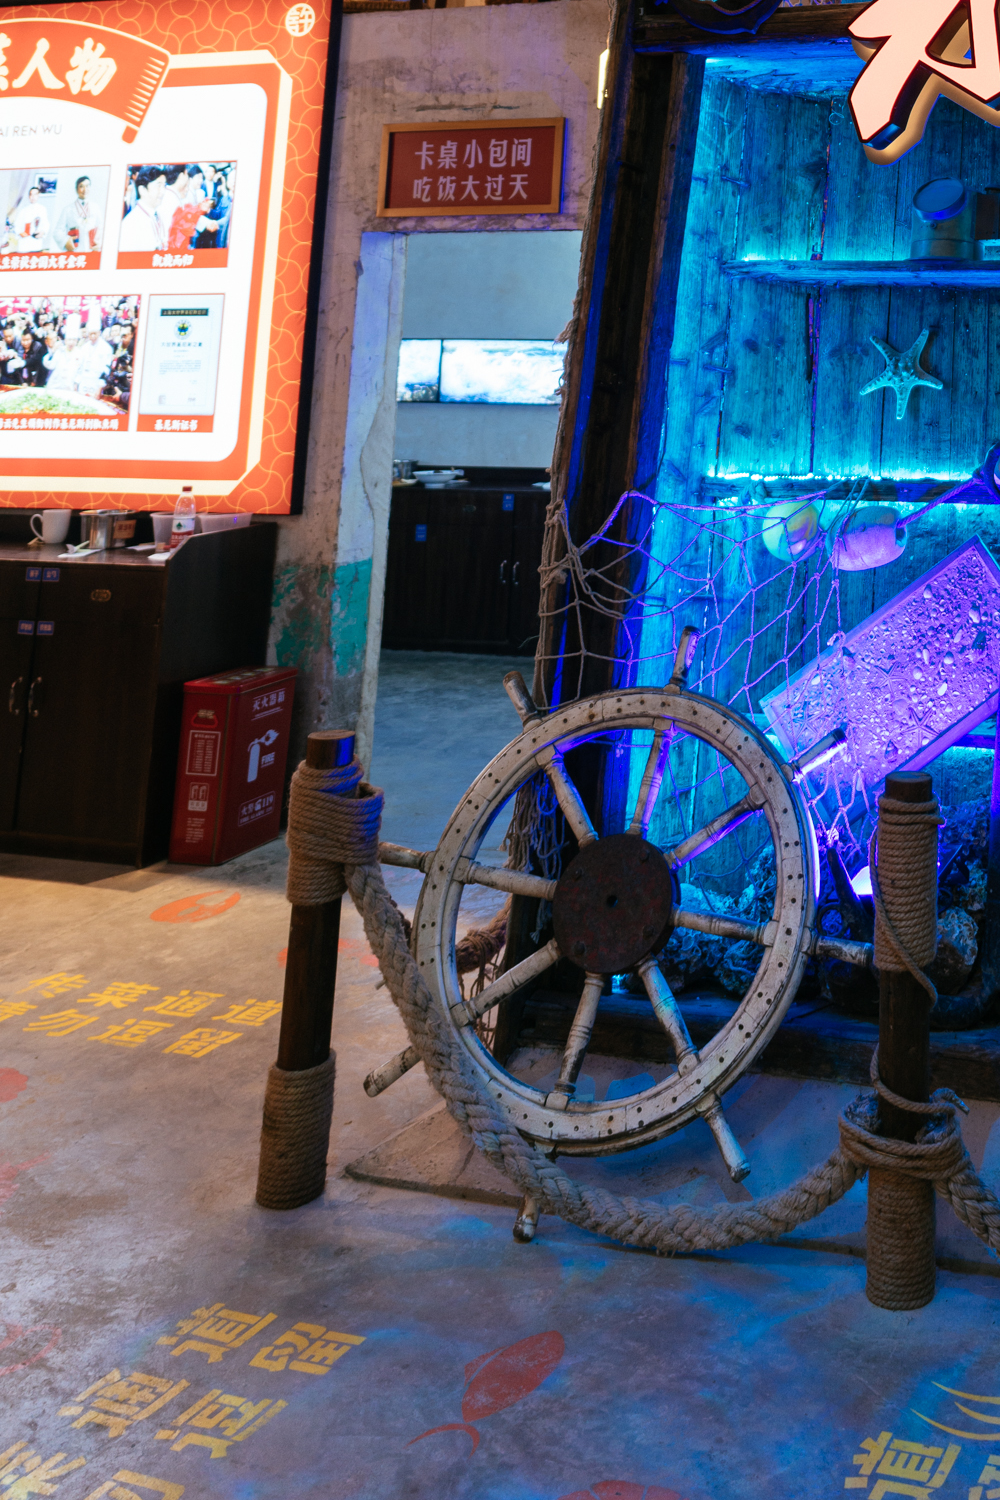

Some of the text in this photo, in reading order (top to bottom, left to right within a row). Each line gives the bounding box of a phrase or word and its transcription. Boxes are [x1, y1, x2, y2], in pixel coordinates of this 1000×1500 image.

[0, 33, 118, 96] 人物
[12, 124, 38, 137] REN
[41, 123, 63, 135] WU
[414, 138, 533, 170] 卡桌小包间
[412, 173, 529, 203] 吃饭大过天
[0, 254, 87, 270] 生荣获全国大赛金奖
[154, 419, 198, 431] 基尼斯证书
[252, 690, 286, 713] 灭火器箱
[261, 752, 275, 766] FIRE
[15, 972, 284, 1027] 传菜通道
